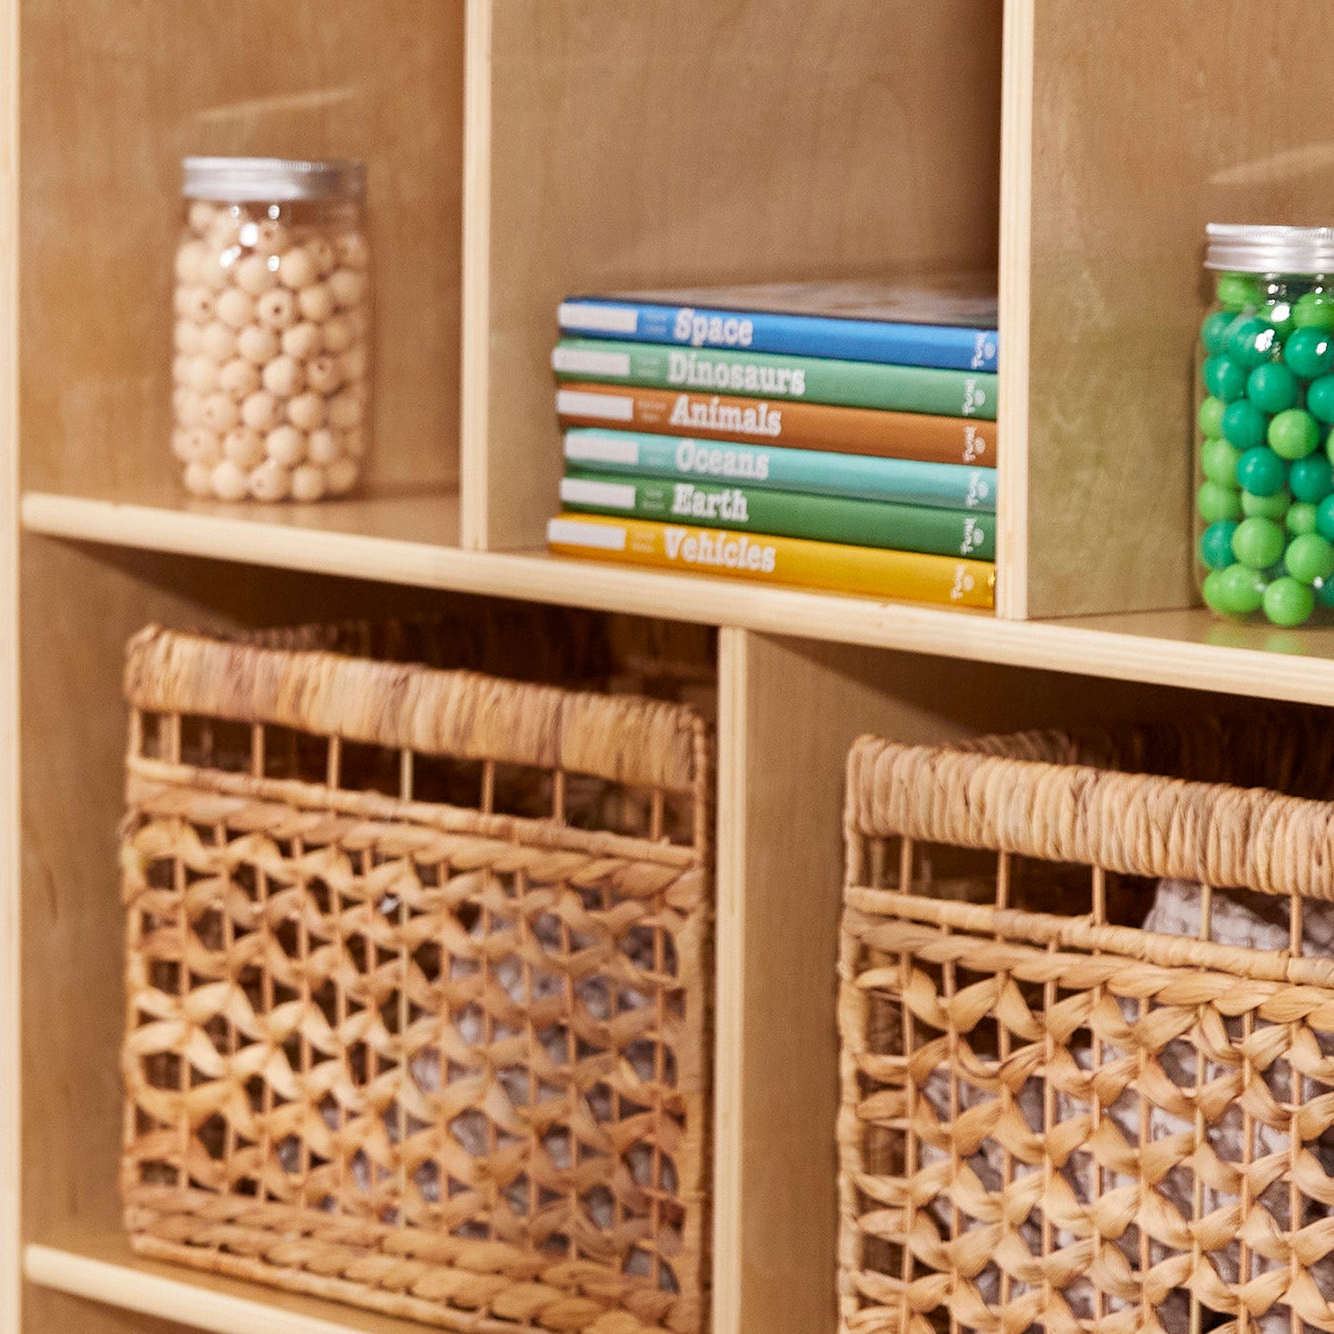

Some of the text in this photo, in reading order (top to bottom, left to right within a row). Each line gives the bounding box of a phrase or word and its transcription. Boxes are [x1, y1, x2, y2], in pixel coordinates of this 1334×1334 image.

[673, 307, 753, 348] Space
[668, 351, 805, 396] Dinosaurs
[669, 394, 782, 437] Animals
[675, 439, 769, 480] Oceans
[671, 483, 749, 522] Earth
[664, 527, 776, 573] Vehicles
